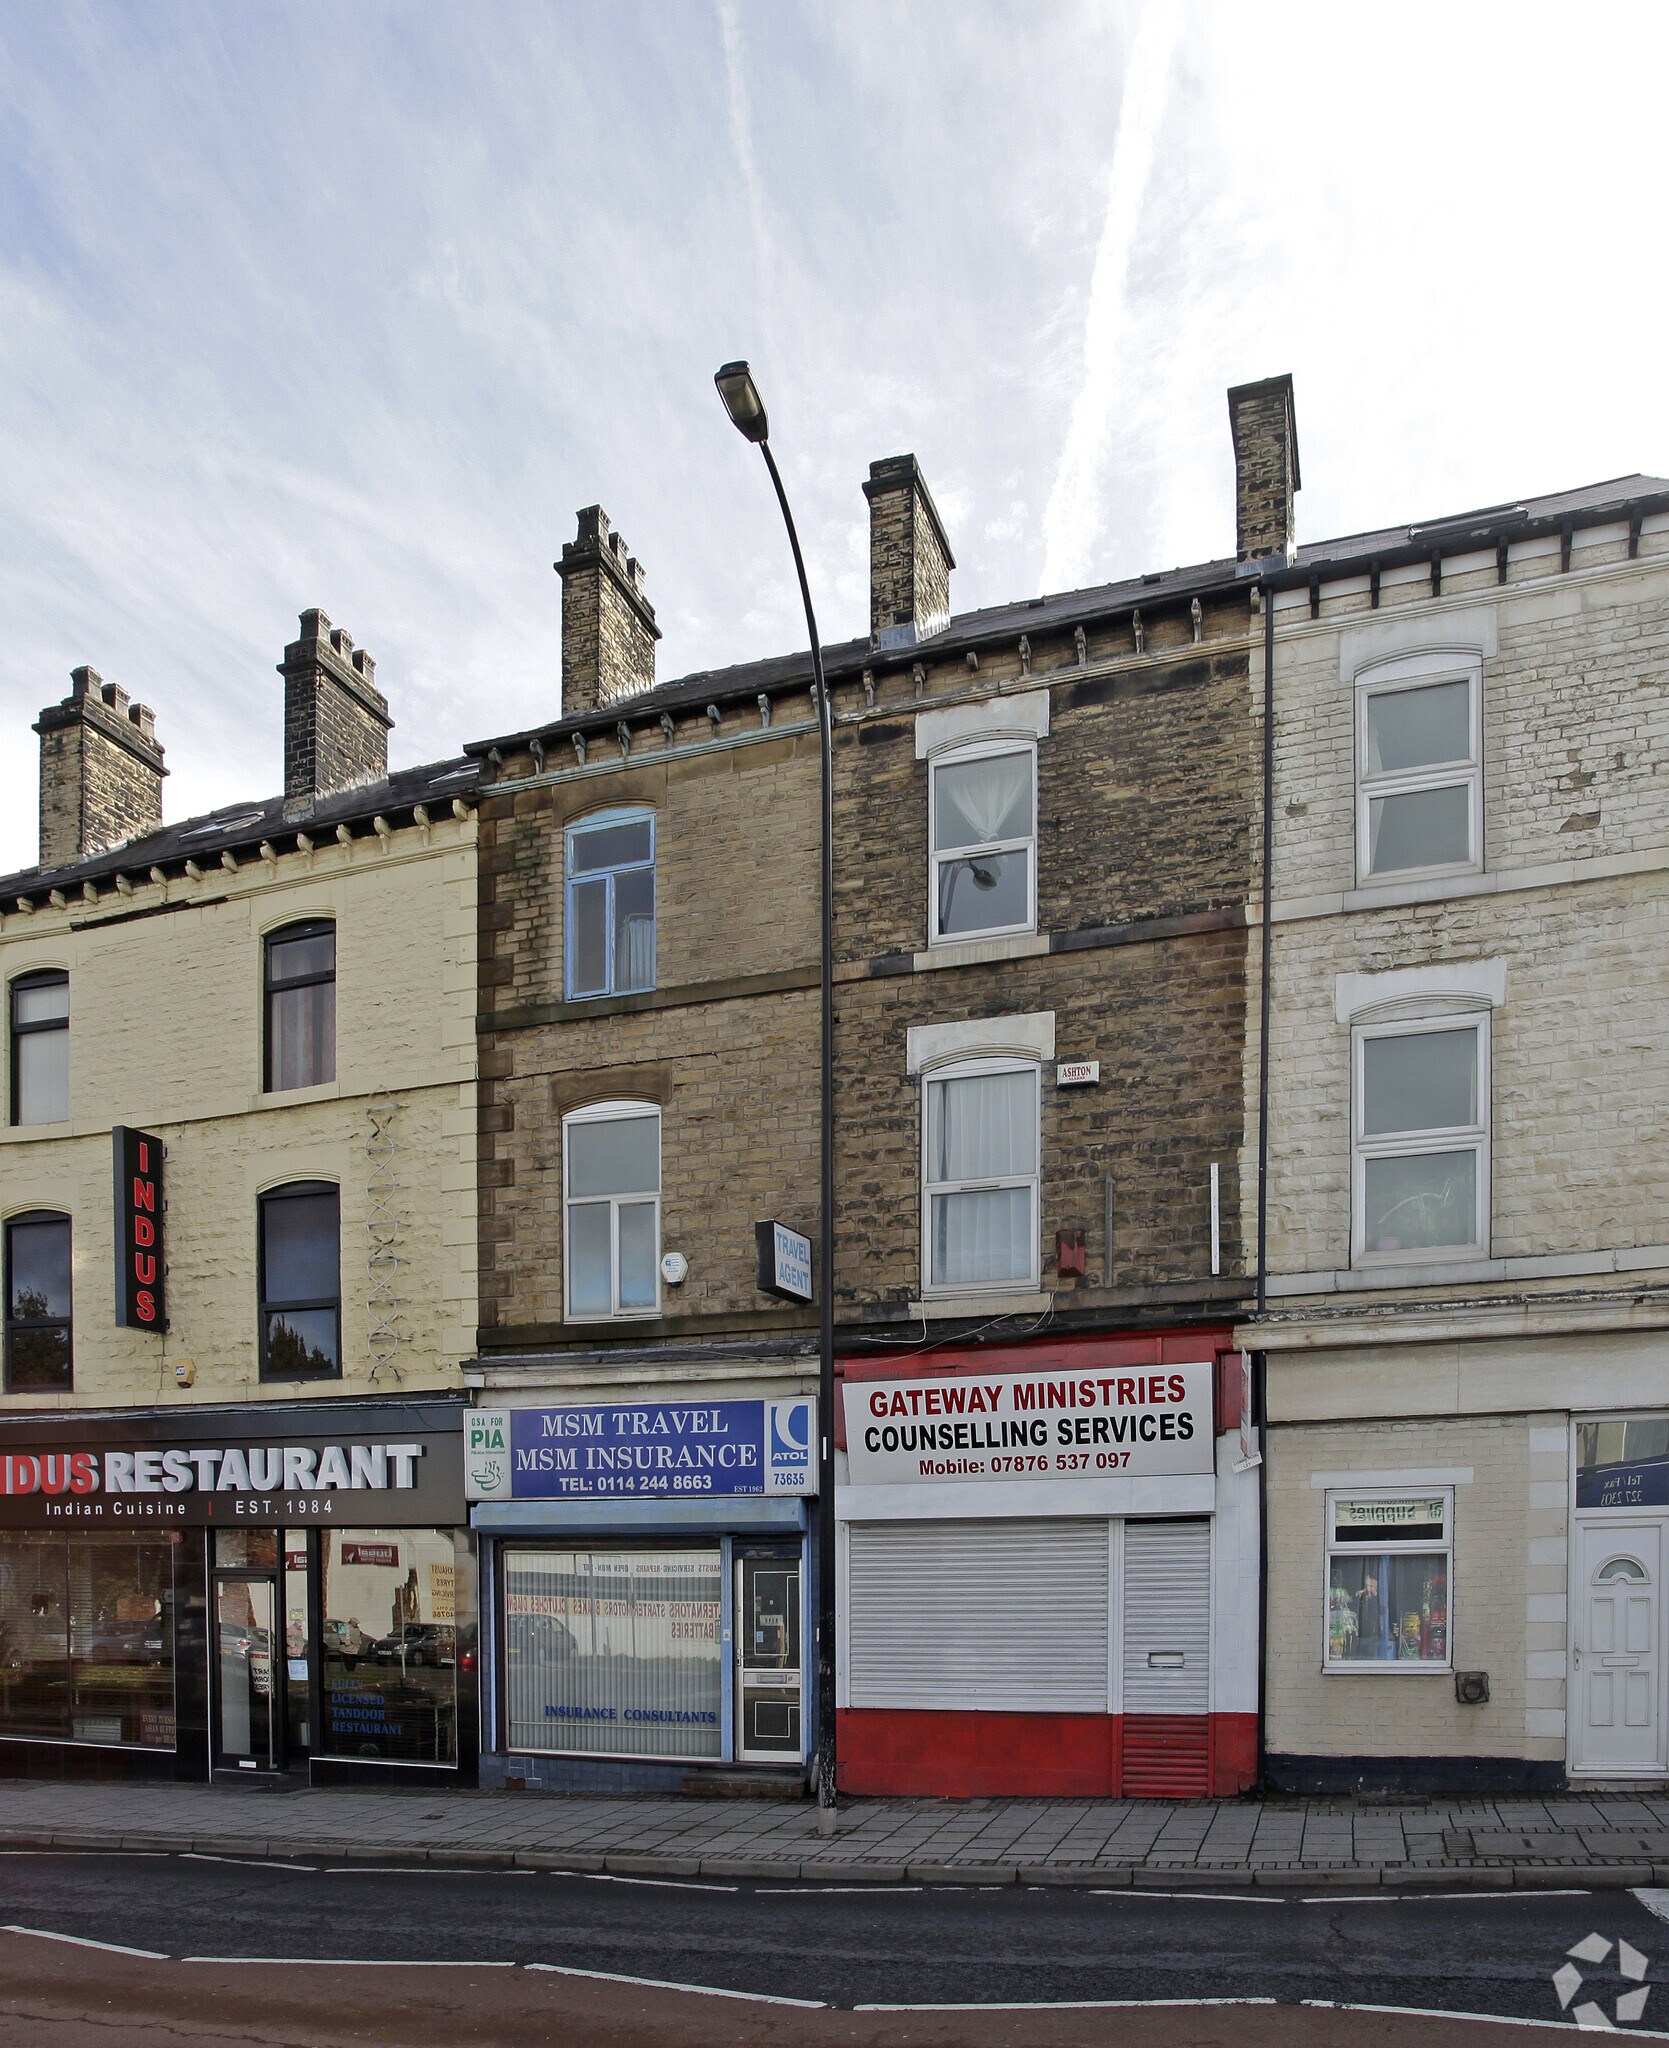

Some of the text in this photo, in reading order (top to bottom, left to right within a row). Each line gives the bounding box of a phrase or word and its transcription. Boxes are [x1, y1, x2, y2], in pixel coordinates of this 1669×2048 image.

[1062, 1066, 1091, 1077] ASHTON
[133, 1141, 156, 1321] INDUS
[776, 1231, 810, 1265] TRAVEL
[779, 1261, 809, 1291] AGENT
[869, 1375, 1186, 1418] GATEWAY MINISTRIES
[471, 1417, 503, 1427] GSA FOR
[541, 1410, 729, 1437] MSM TRAVEL
[471, 1429, 505, 1449] PIA
[864, 1412, 1194, 1453] COUNSELLING SERVICES
[516, 1444, 757, 1471] MSM INSURANCE
[772, 1451, 808, 1461] ATOL
[919, 1451, 1131, 1476] Mobile: 07876 537 097
[104, 1444, 422, 1493] RESTAURANT
[559, 1474, 712, 1491] TEL: 0114 244 8663
[773, 1472, 805, 1486] 73635
[748, 1485, 763, 1493] 1962
[46, 1501, 186, 1516] Indian Cuisine
[235, 1499, 333, 1514] EST. 1984
[331, 1679, 364, 1690] FULLY
[331, 1693, 385, 1706] LICENSED
[331, 1708, 386, 1720] TANDOOR
[545, 1705, 717, 1723] INSURANCE CONSULTANTS
[331, 1721, 404, 1736] RESTAURANT
